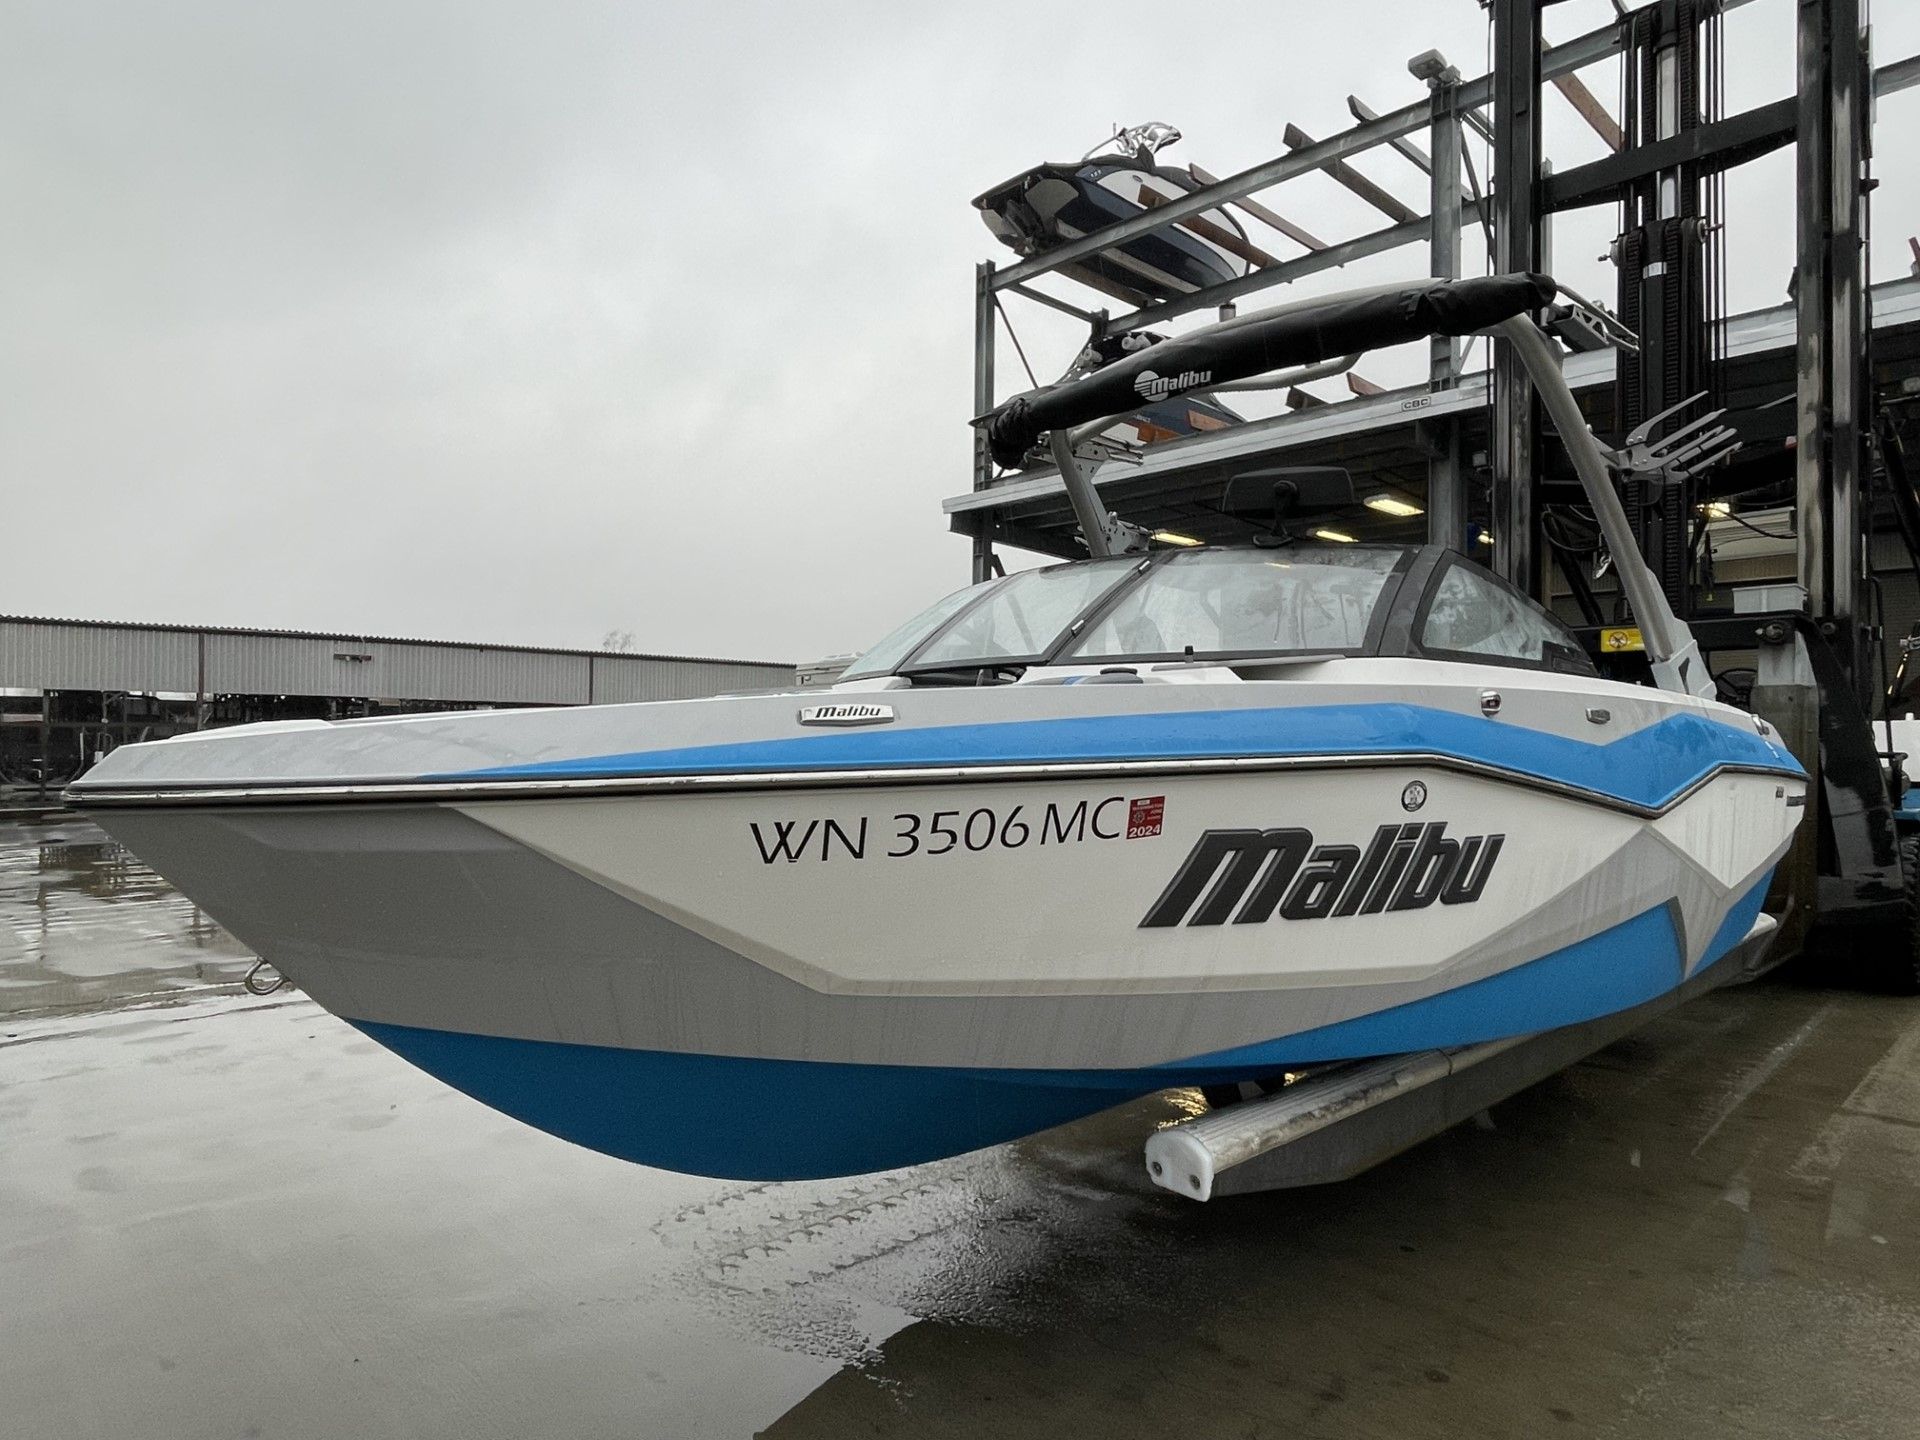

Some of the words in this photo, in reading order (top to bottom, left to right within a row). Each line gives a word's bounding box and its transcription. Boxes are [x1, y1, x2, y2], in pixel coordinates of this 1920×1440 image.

[750, 816, 868, 864] WN
[887, 804, 1030, 858] 3506
[1040, 796, 1125, 846] MC
[1128, 824, 1161, 838] 2024
